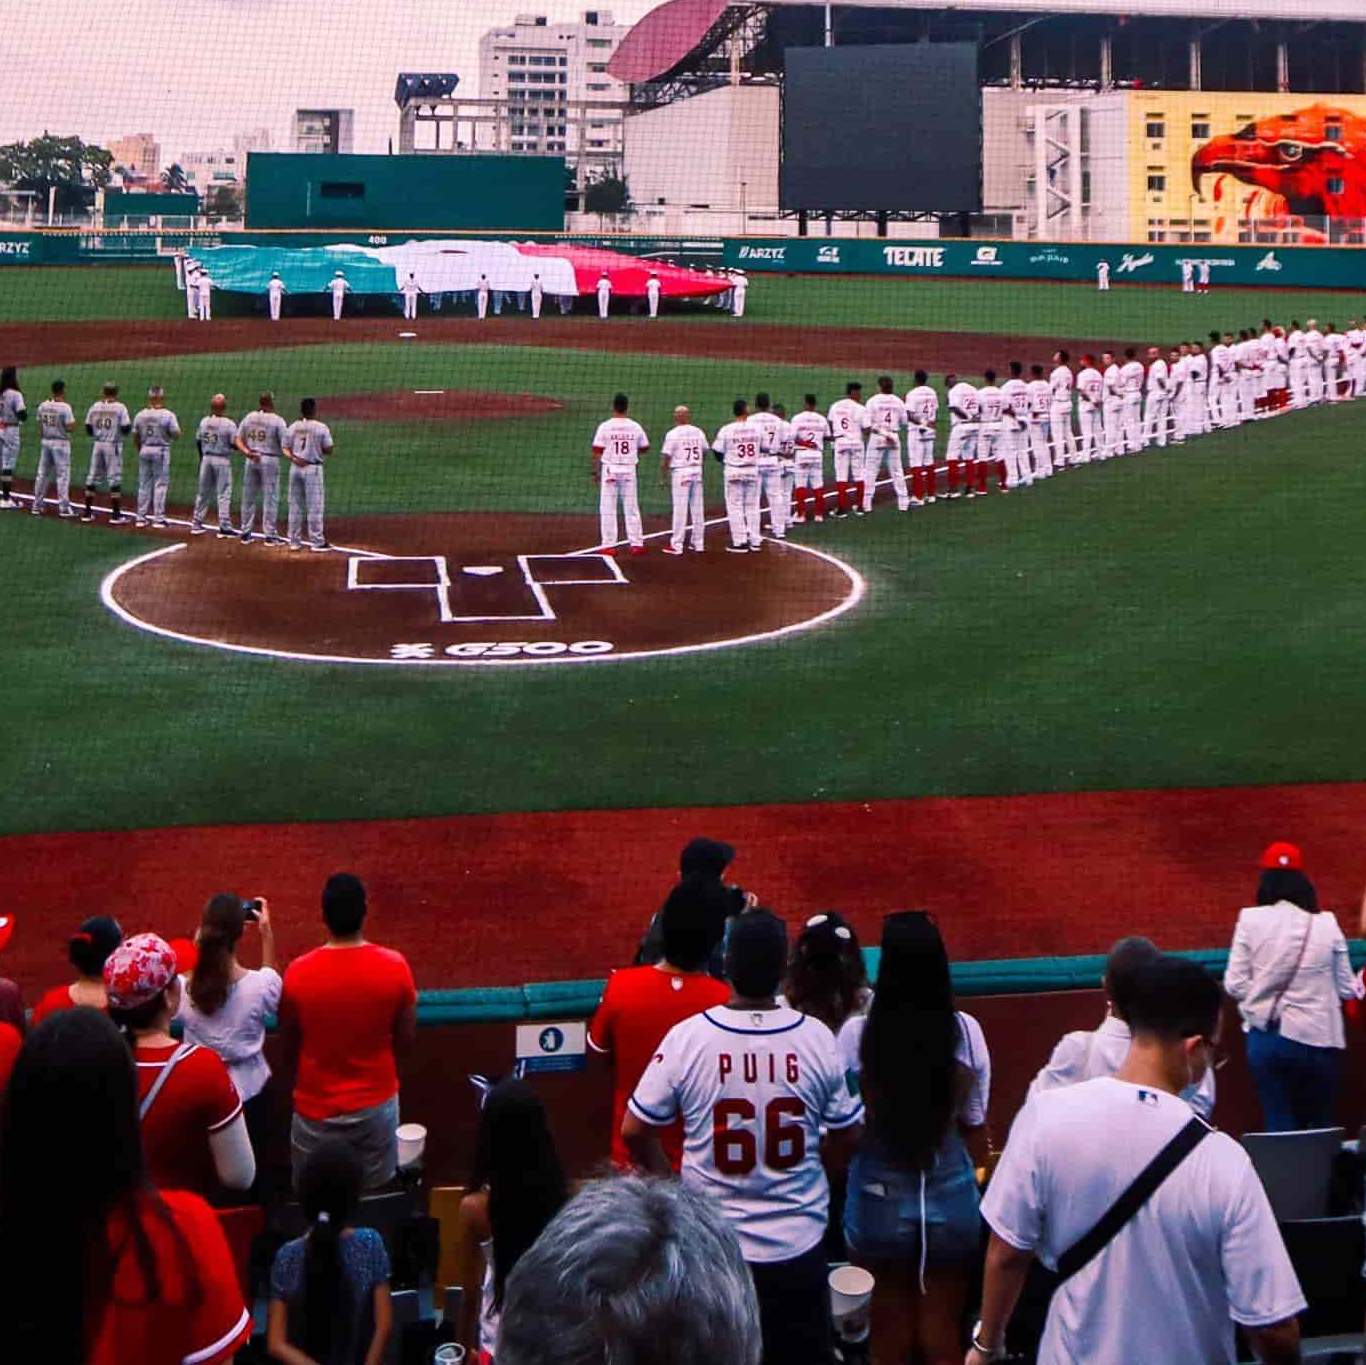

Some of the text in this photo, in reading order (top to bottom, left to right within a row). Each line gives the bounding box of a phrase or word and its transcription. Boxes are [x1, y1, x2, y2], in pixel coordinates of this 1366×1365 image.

[883, 246, 946, 267] TECATE
[840, 417, 850, 430] 6
[884, 411, 892, 425] 4
[613, 441, 630, 455] 18
[683, 447, 700, 461] 75
[737, 443, 756, 459] 38
[444, 641, 614, 657] G500
[719, 1053, 801, 1084] PUIG
[712, 1096, 807, 1176] 66
